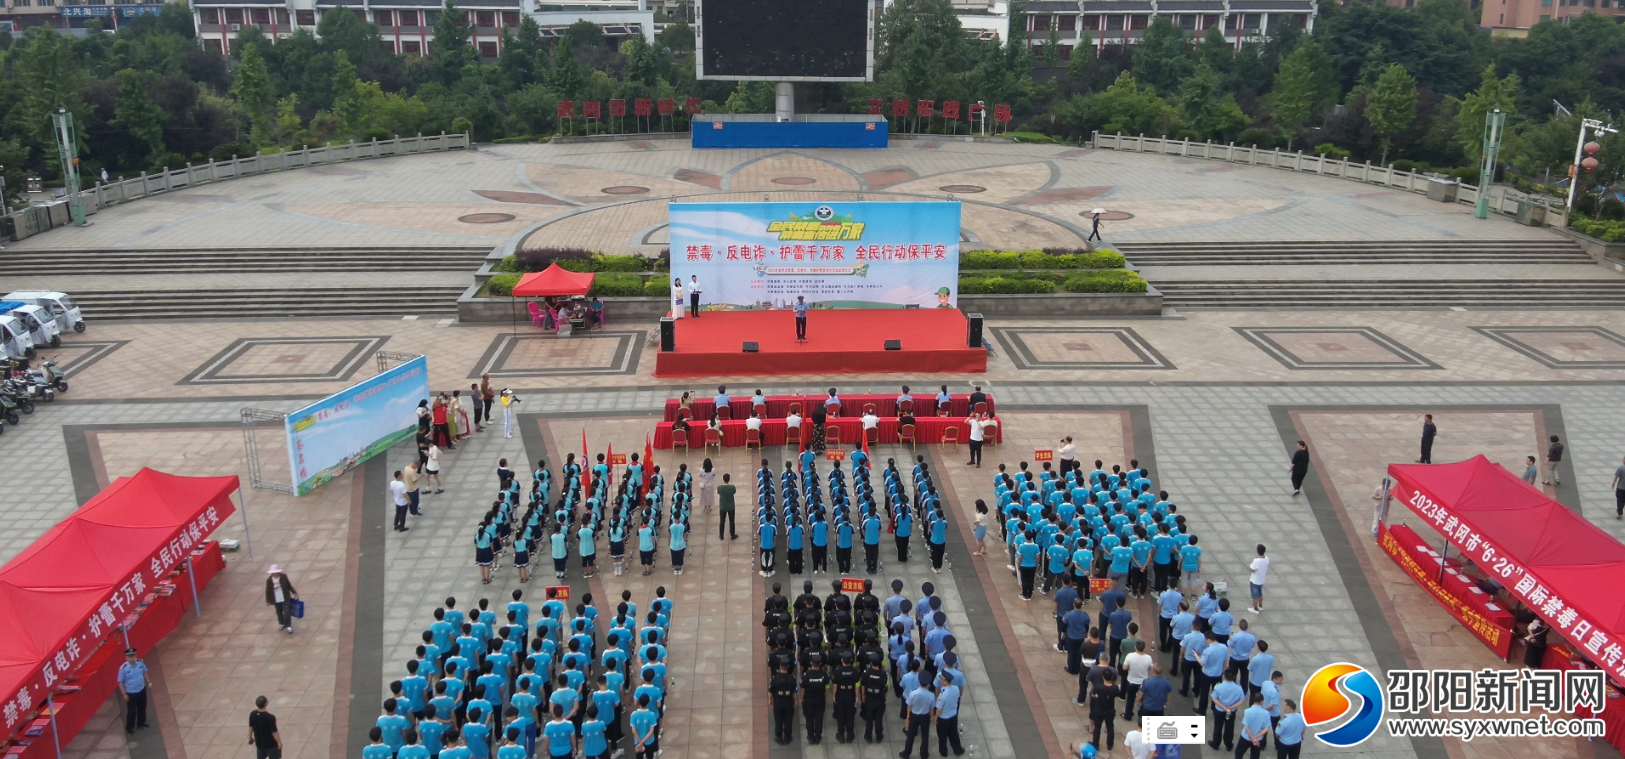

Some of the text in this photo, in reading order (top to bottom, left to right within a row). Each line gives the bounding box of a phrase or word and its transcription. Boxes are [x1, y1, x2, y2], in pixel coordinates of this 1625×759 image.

[855, 244, 947, 260] 全民行动保平安
[150, 505, 219, 578] 全民行动保平安
